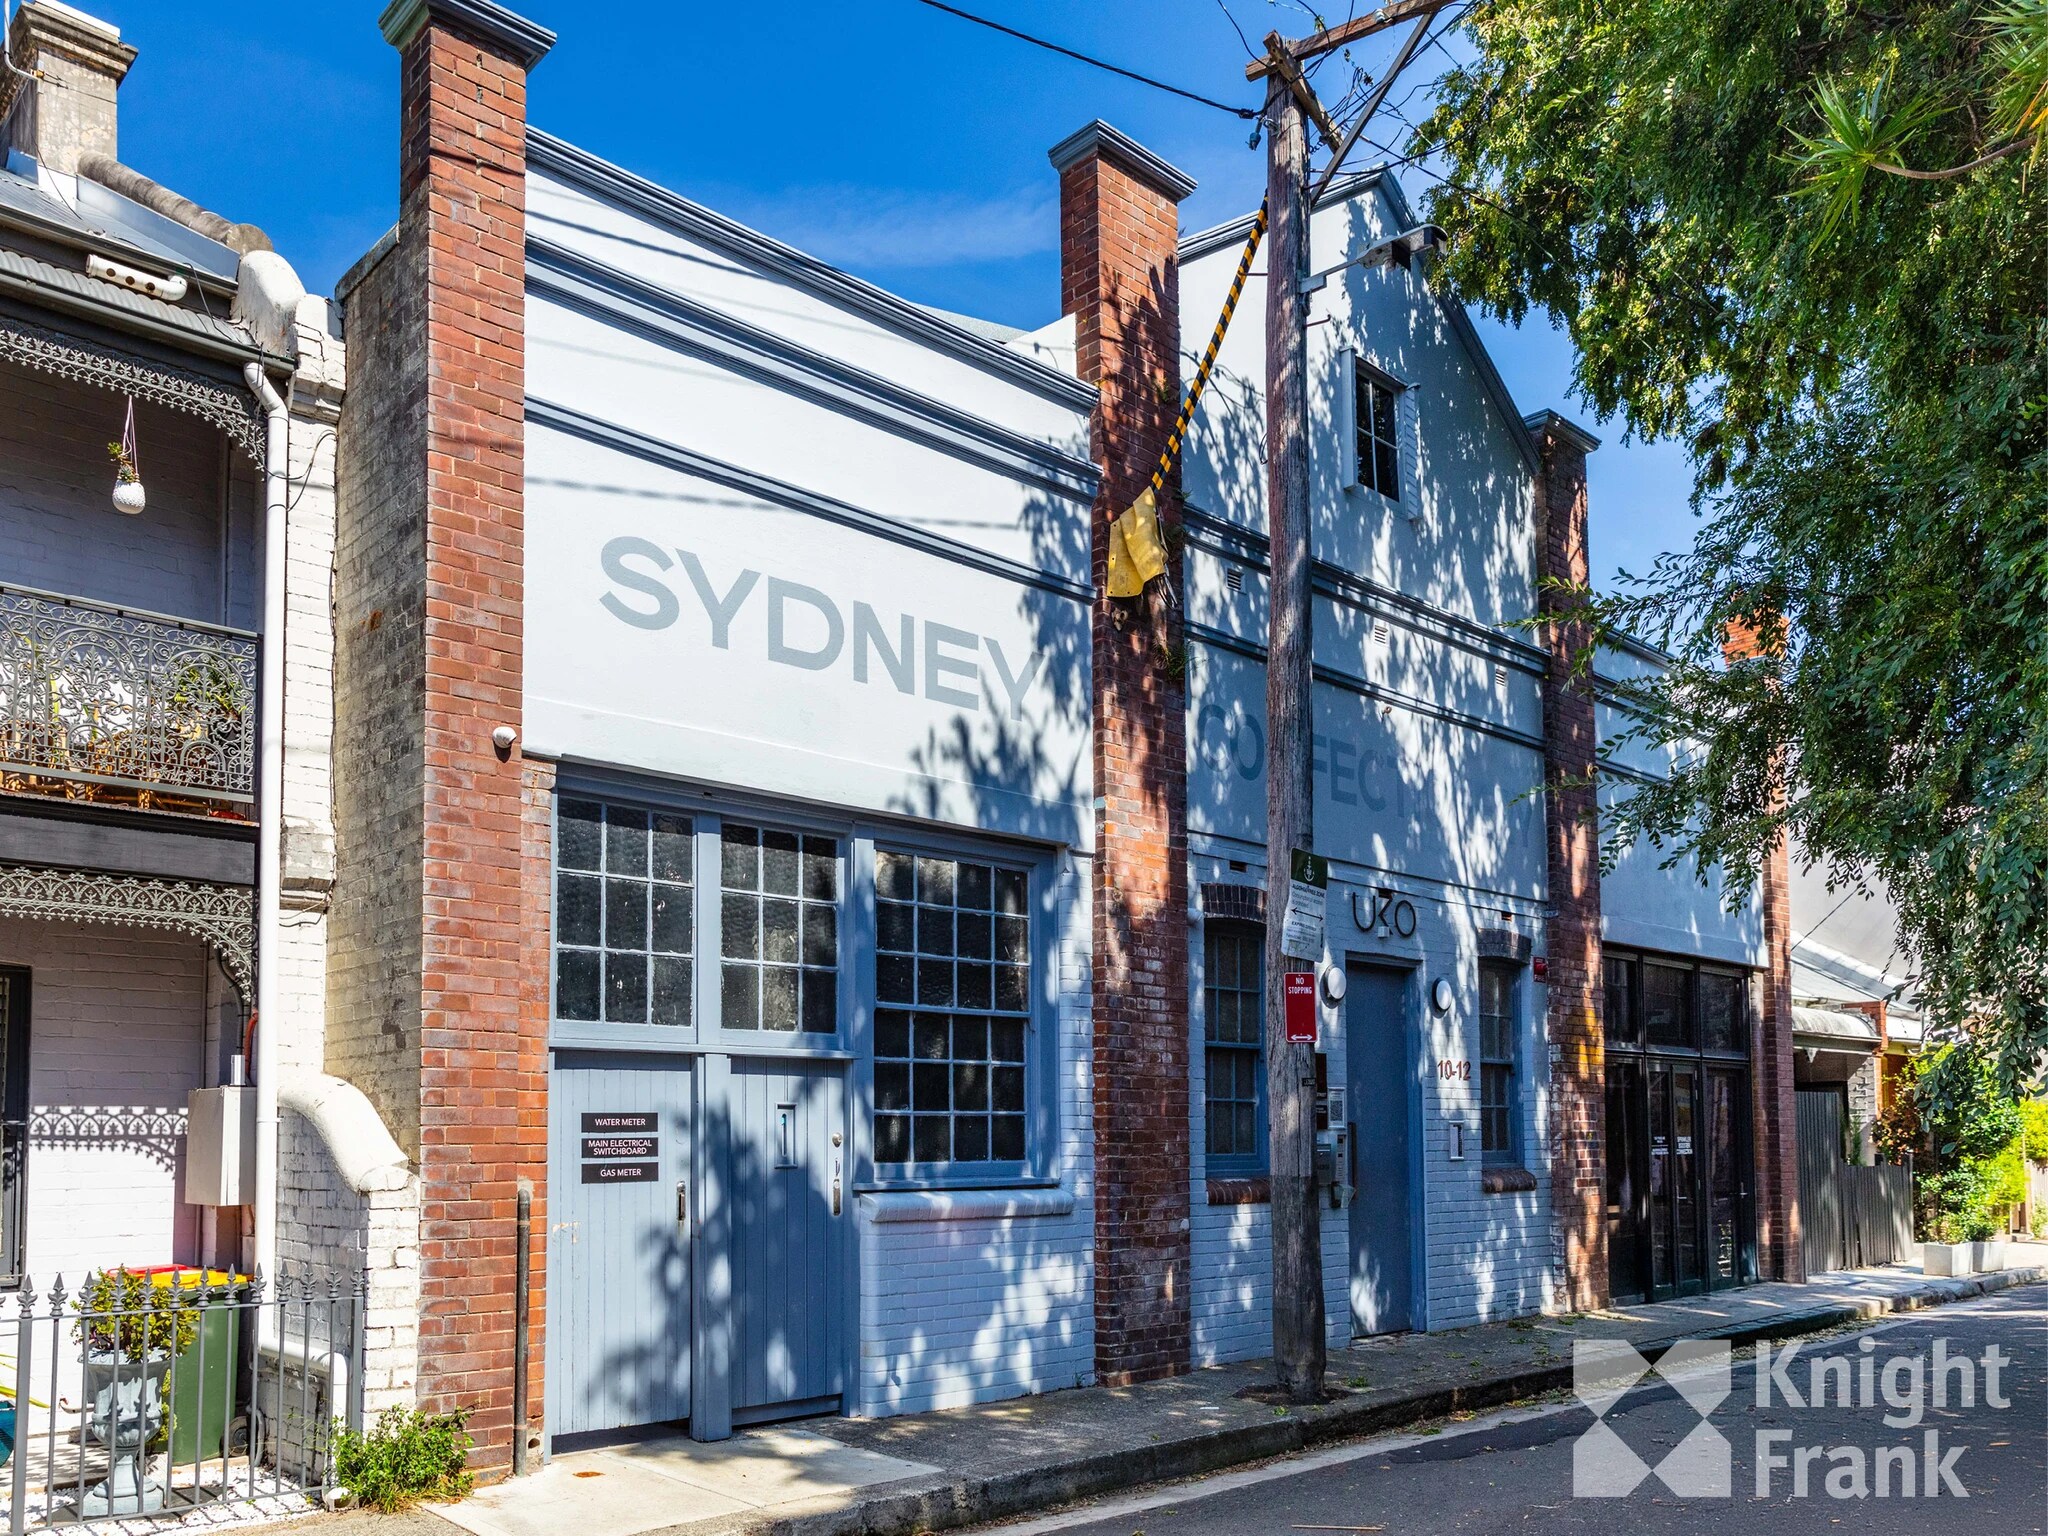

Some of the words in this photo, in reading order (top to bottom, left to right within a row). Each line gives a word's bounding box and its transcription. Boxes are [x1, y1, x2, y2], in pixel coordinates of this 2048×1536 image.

[599, 535, 1044, 722] SYDNEY
[1295, 977, 1305, 985] NO
[1288, 986, 1313, 995] STOPPING
[1437, 1059, 1472, 1081] 10-12
[594, 1118, 620, 1126] WATER
[621, 1117, 646, 1126] METER
[588, 1139, 609, 1147] MAIN
[610, 1139, 652, 1147] ELECTRICAL
[593, 1147, 647, 1155] SWITCHBOARD
[600, 1169, 616, 1177] GAS
[617, 1168, 642, 1177] METER
